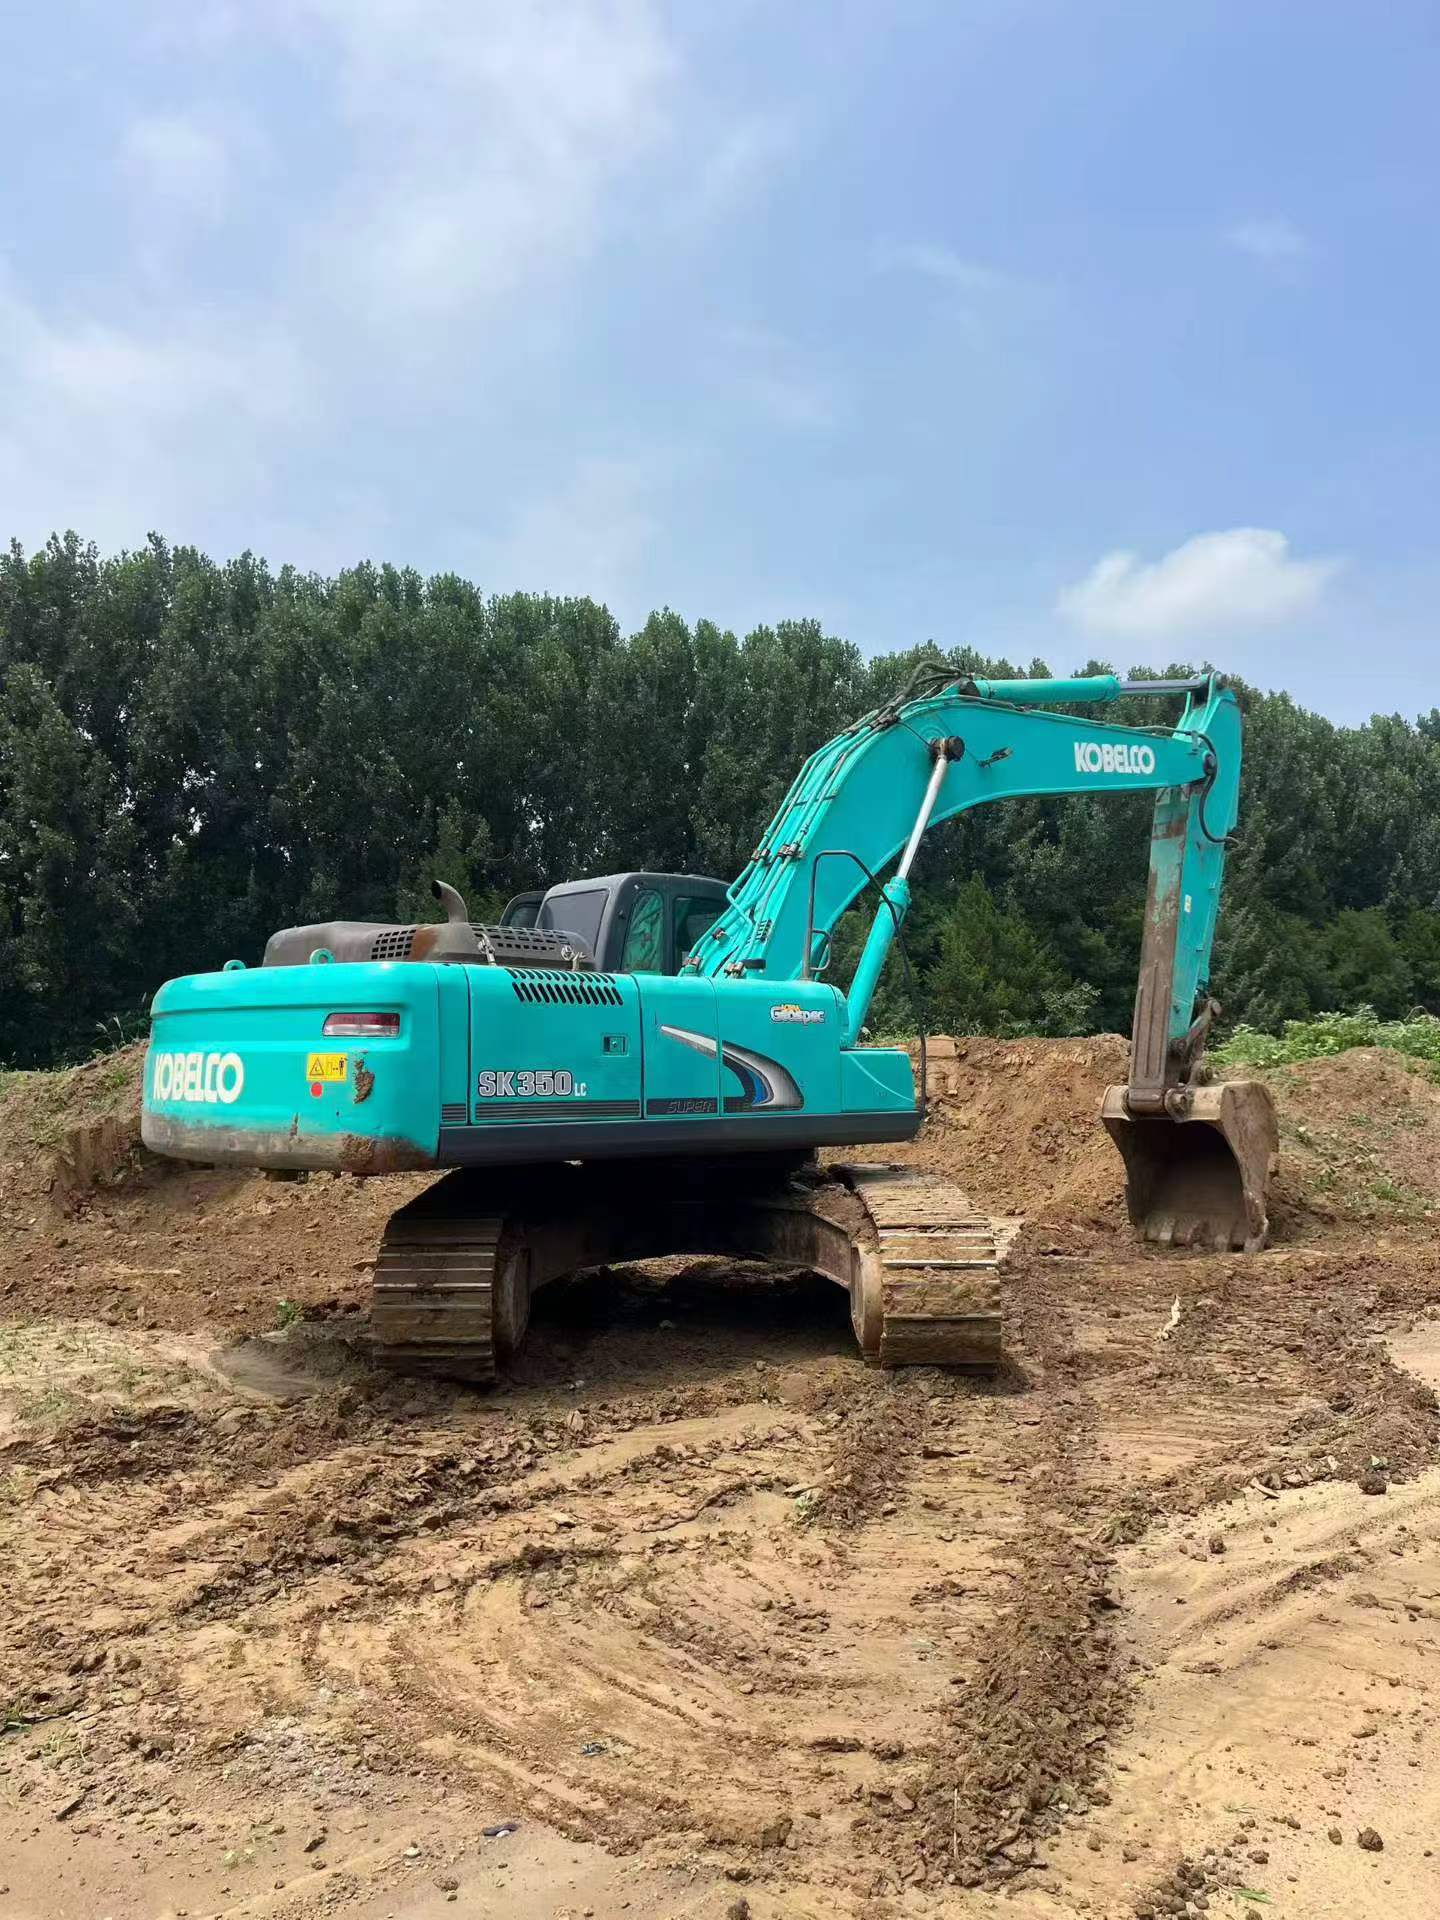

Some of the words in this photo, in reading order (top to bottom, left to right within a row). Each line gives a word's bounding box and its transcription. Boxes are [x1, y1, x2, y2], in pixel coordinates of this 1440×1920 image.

[1074, 742, 1155, 774] KOBELCO
[153, 1052, 244, 1104] KOBELCO
[574, 1082, 587, 1097] LC
